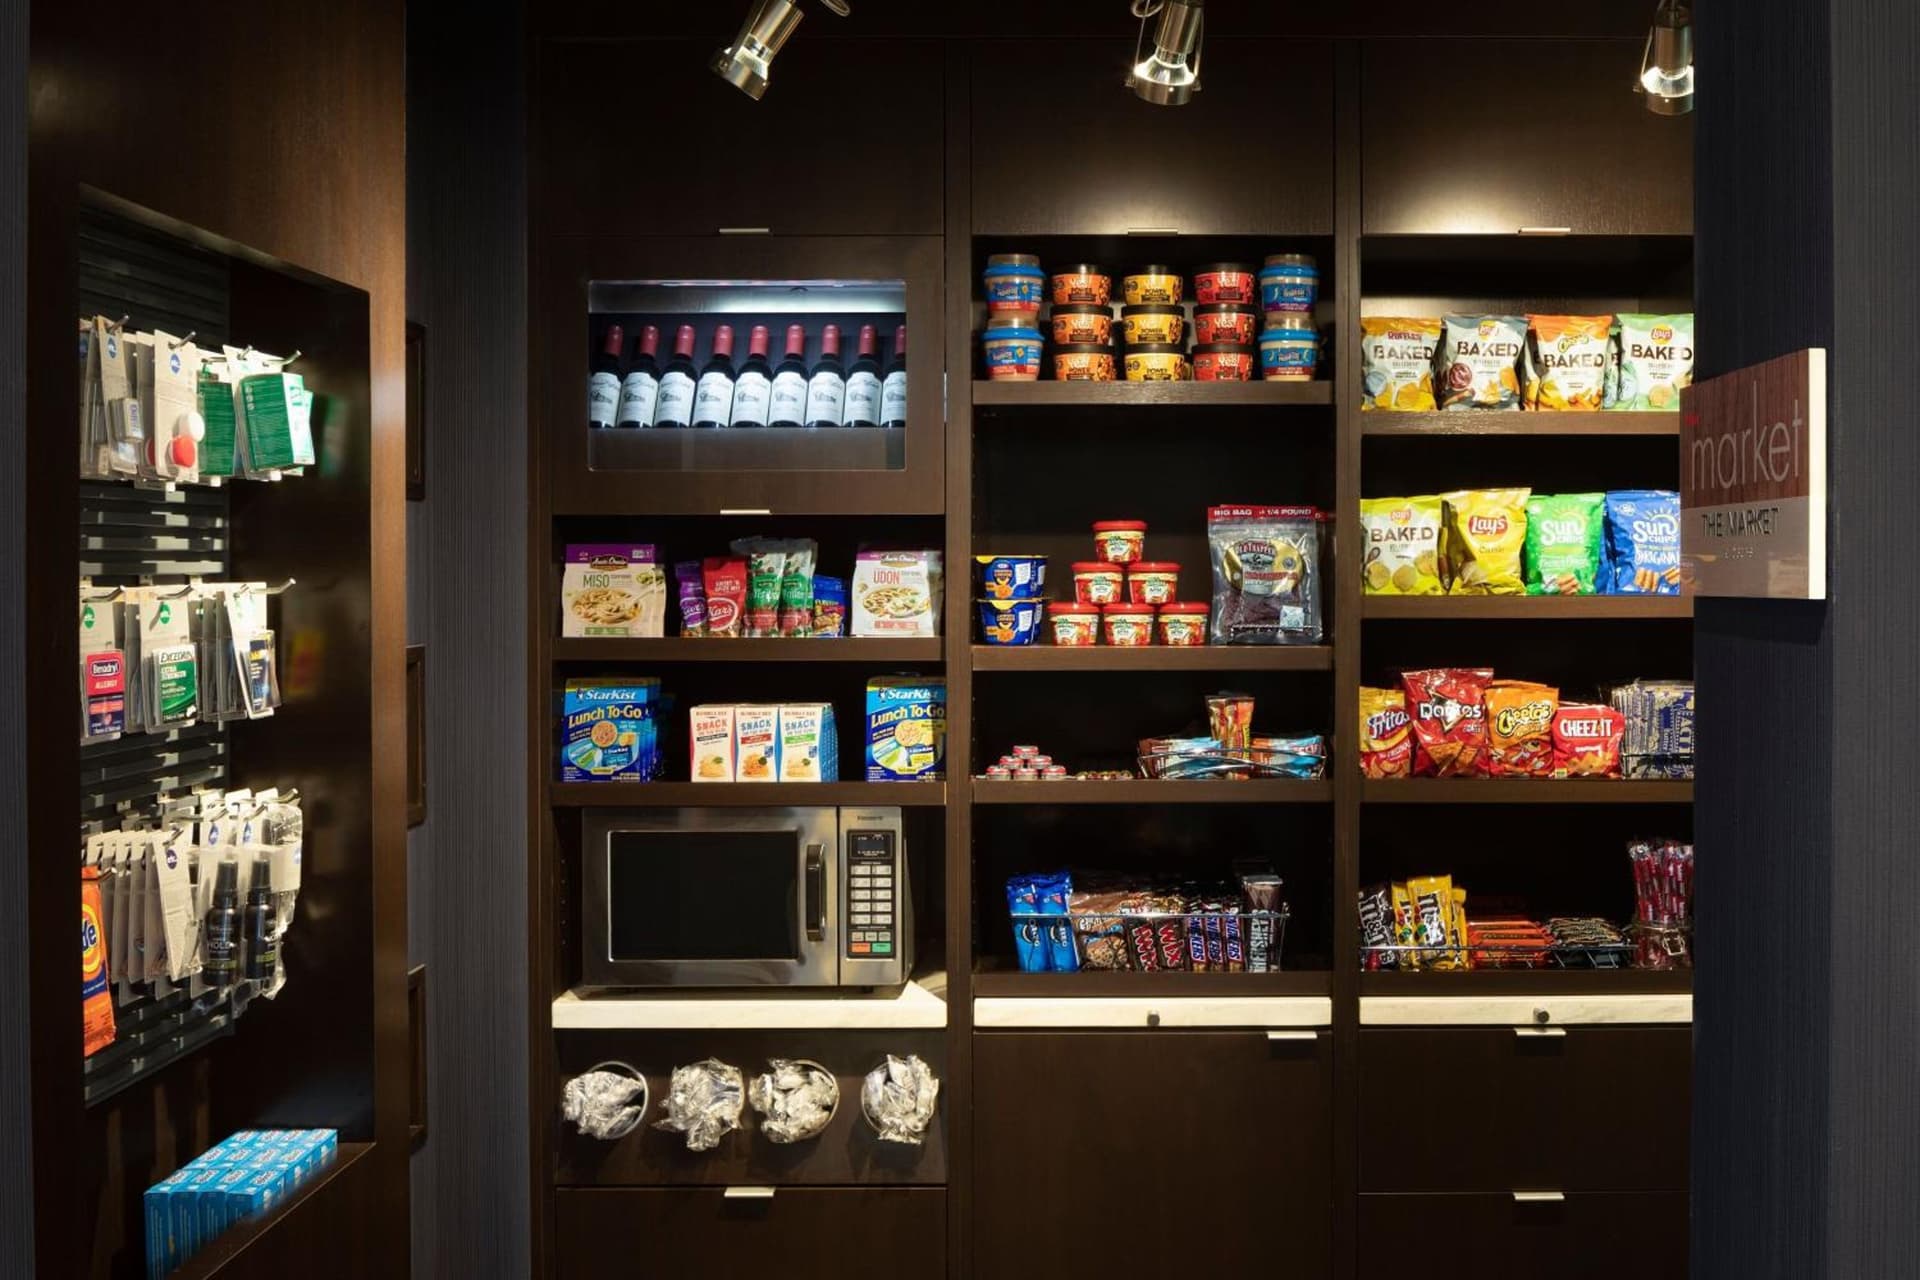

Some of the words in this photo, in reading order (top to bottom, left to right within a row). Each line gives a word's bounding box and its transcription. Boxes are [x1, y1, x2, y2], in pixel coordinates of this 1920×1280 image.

[1373, 345, 1433, 360] BAKED
[1457, 341, 1519, 357] BAKED
[1631, 344, 1692, 360] BAKED
[1544, 353, 1604, 368] BAKED
[1691, 380, 1803, 492] market
[1632, 515, 1679, 543] Sun
[1701, 513, 1723, 537] THE
[1727, 507, 1779, 537] MARKET
[1371, 527, 1434, 542] BAKED
[1541, 519, 1586, 546] Sun
[583, 574, 610, 588] MISO
[873, 570, 901, 584] UDON
[586, 688, 637, 700] StarKist
[888, 687, 938, 700] StarKist
[568, 708, 605, 729] Lunch
[606, 704, 642, 719] To-Go
[872, 706, 908, 728] Lunch
[911, 704, 945, 718] To-Go
[1419, 702, 1482, 720] Doos
[696, 720, 727, 731] SNACK
[741, 720, 771, 731] SNACK
[785, 720, 815, 731] SNACK
[1367, 711, 1410, 739] Fritos
[1497, 702, 1550, 737] Cheetos
[82, 919, 98, 951] de
